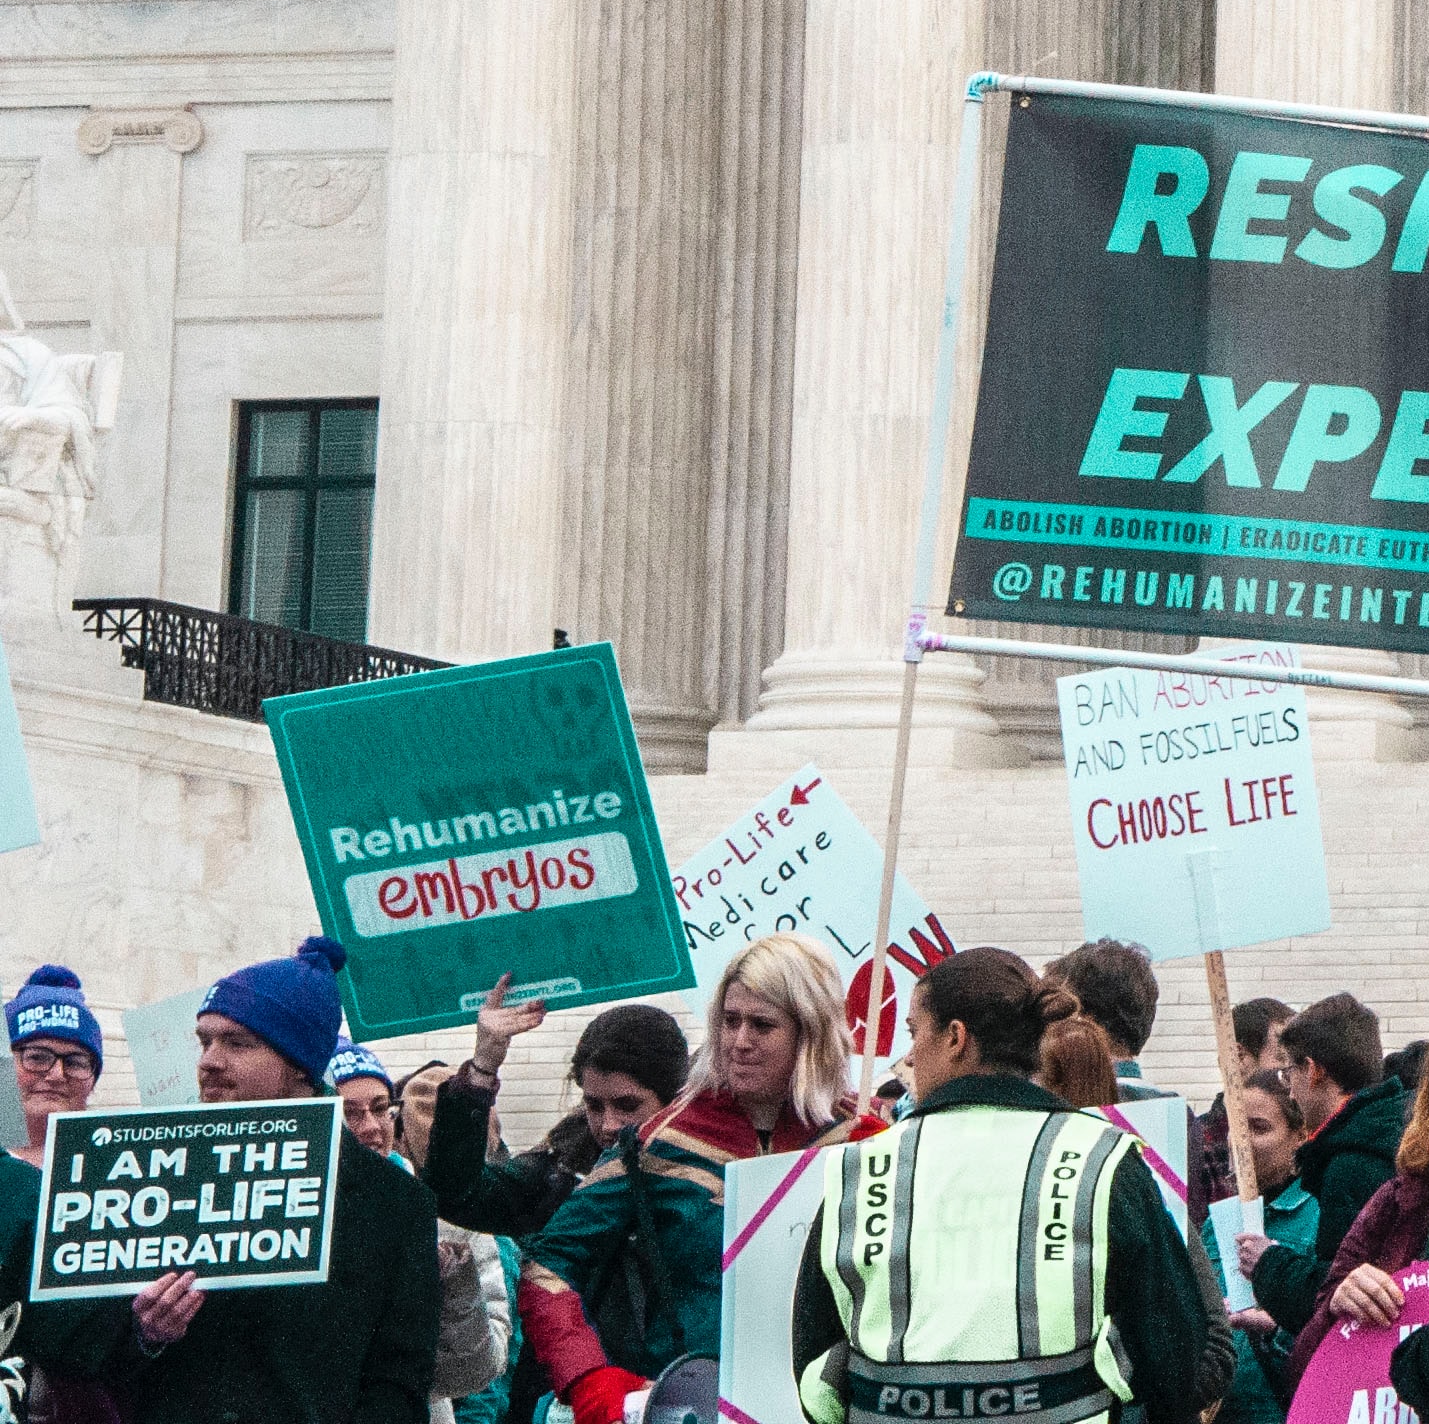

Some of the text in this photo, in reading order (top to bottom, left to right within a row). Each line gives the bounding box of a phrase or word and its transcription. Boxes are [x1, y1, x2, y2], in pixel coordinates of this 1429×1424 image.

[982, 508, 1084, 538] ABOLISH
[1094, 515, 1212, 545] ABORTION
[1240, 526, 1368, 558] ERADICATE
[1074, 674, 1140, 726] BAN
[1074, 739, 1127, 778] AND
[329, 789, 622, 864] Rehumanize
[1087, 774, 1298, 850] CHOOSE LIFE
[378, 848, 595, 920] embryos
[671, 807, 794, 911] Pro-Life
[17, 1004, 80, 1025] PRO-LIFE
[18, 1017, 80, 1036] PRO-WOMAN
[112, 1119, 298, 1145] STUDENTSFORLIFE.ORG
[71, 1140, 310, 1183] I AM THE
[52, 1177, 322, 1234] PRO-LIFE
[863, 1155, 891, 1266] USCP
[1043, 1150, 1082, 1261] POLICE
[53, 1227, 311, 1274] GENERATION
[876, 1382, 1042, 1416] POLICE
